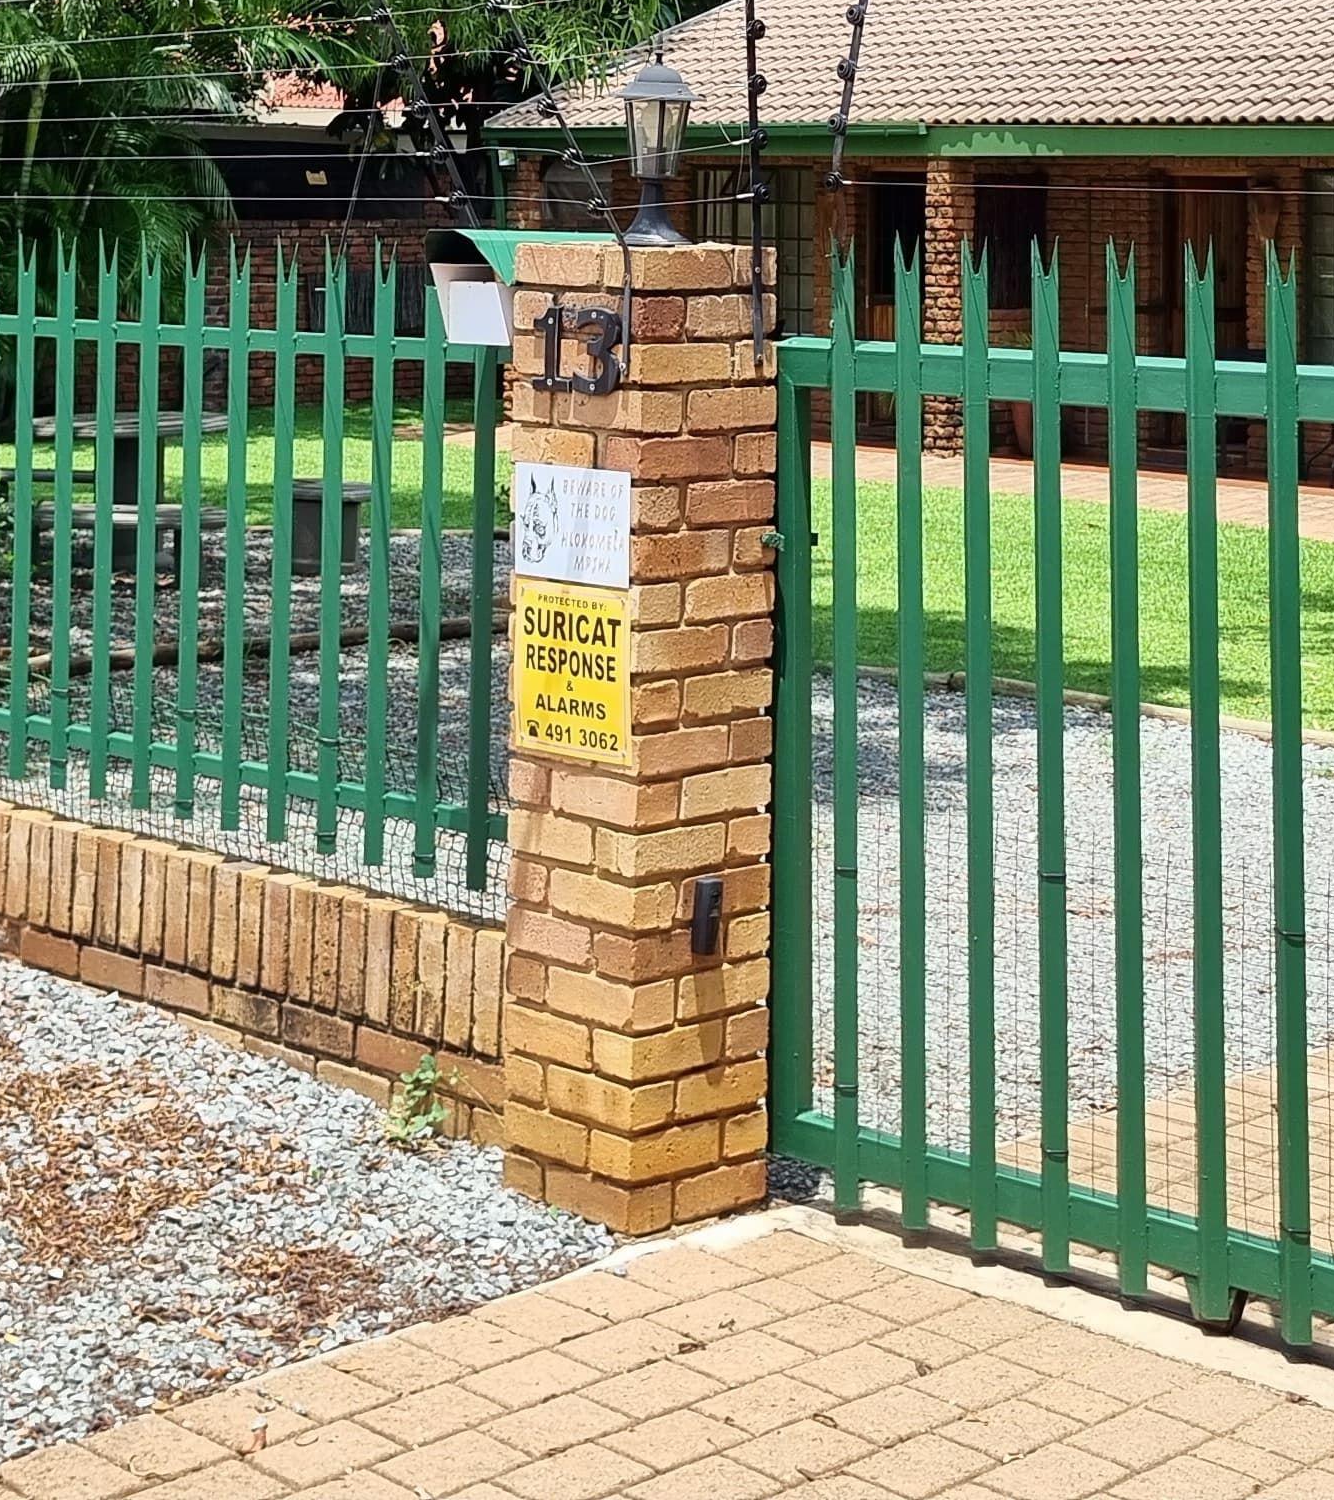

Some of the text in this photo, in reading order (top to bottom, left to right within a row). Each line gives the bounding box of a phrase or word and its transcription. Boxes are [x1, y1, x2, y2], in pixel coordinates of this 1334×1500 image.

[533, 306, 621, 395] 13
[563, 479, 624, 500] BEWARE OF
[571, 502, 616, 521] THE DOG
[538, 593, 607, 612] PROTECTED BY:
[523, 606, 621, 648] SURICAT
[526, 644, 617, 683] RESPONSE
[566, 680, 573, 692] &
[535, 693, 607, 720] ALARMS
[545, 723, 618, 751] 491 3062
